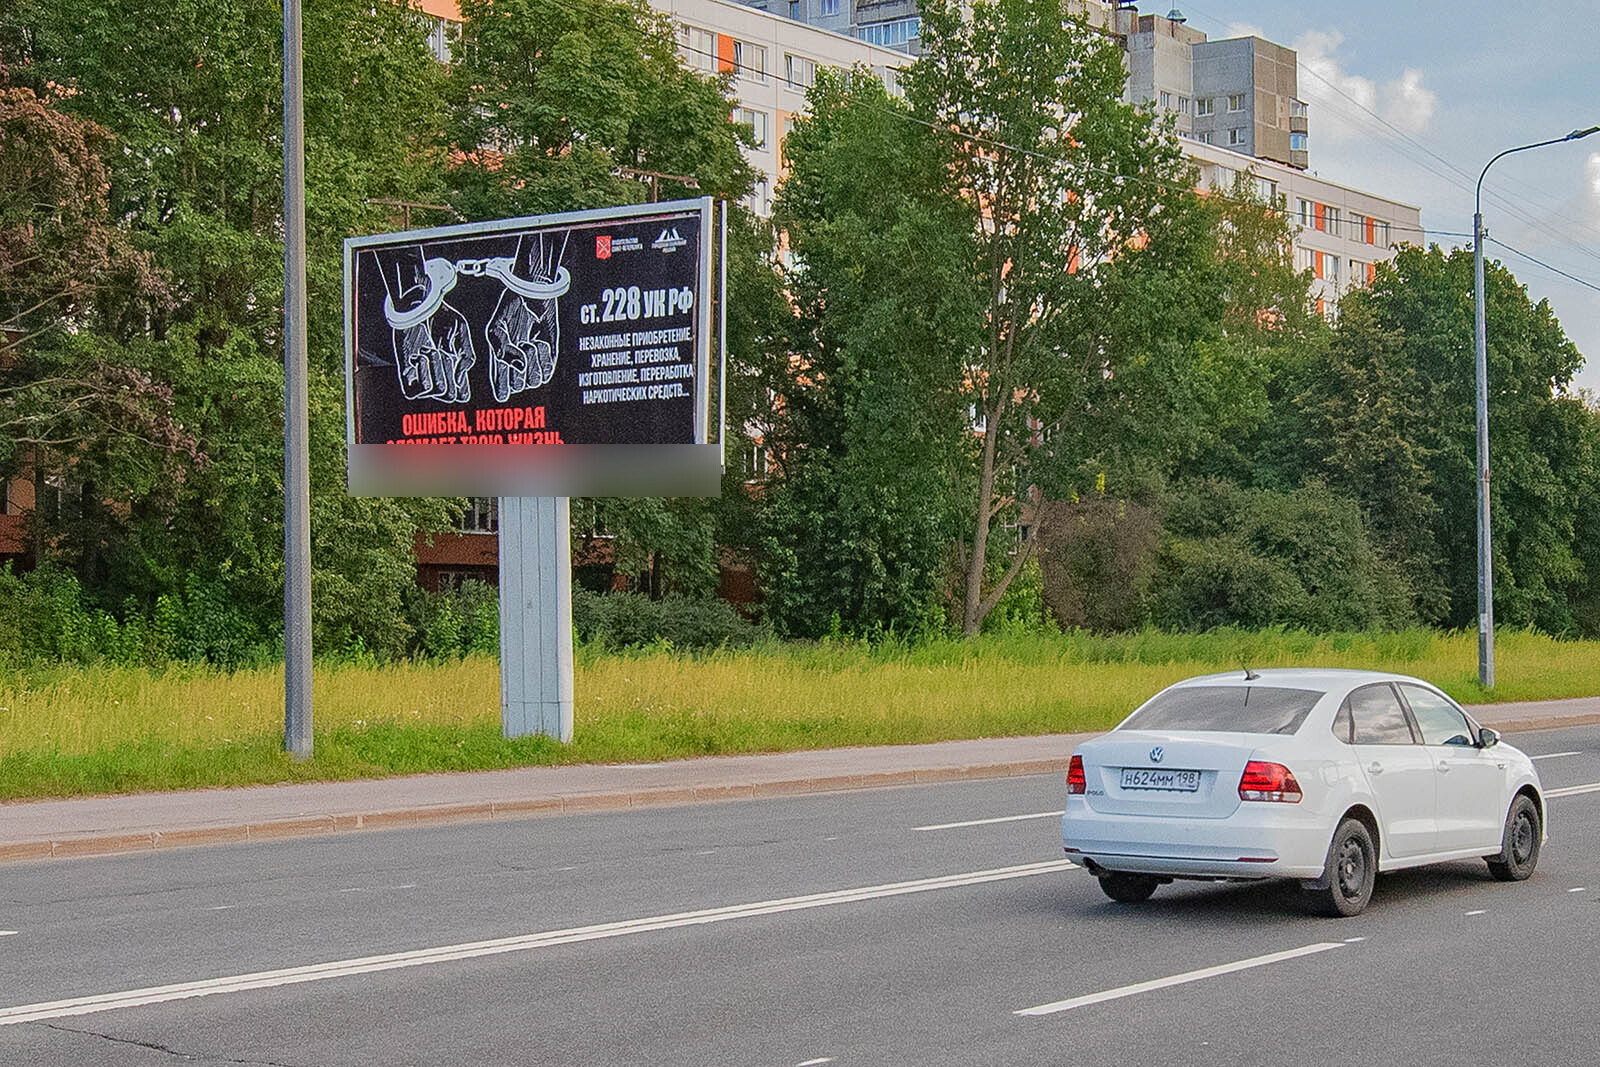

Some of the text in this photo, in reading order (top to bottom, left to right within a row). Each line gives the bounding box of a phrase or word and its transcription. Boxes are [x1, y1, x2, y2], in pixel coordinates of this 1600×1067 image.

[580, 286, 694, 324] ст. 228 УК РФ
[579, 333, 631, 351] НЕЗАКОННЫЕ
[591, 347, 681, 368] ХРАНЕНИЕ, ПЕРЕВОЗКА,
[578, 369, 640, 387] ИЗГОТОВЛЕНИЕ,
[583, 386, 647, 404] НАРКОТИЧЕСКИХ
[402, 406, 546, 436] ОШИБКА, КОТОРАЯ
[1176, 772, 1196, 784] 198
